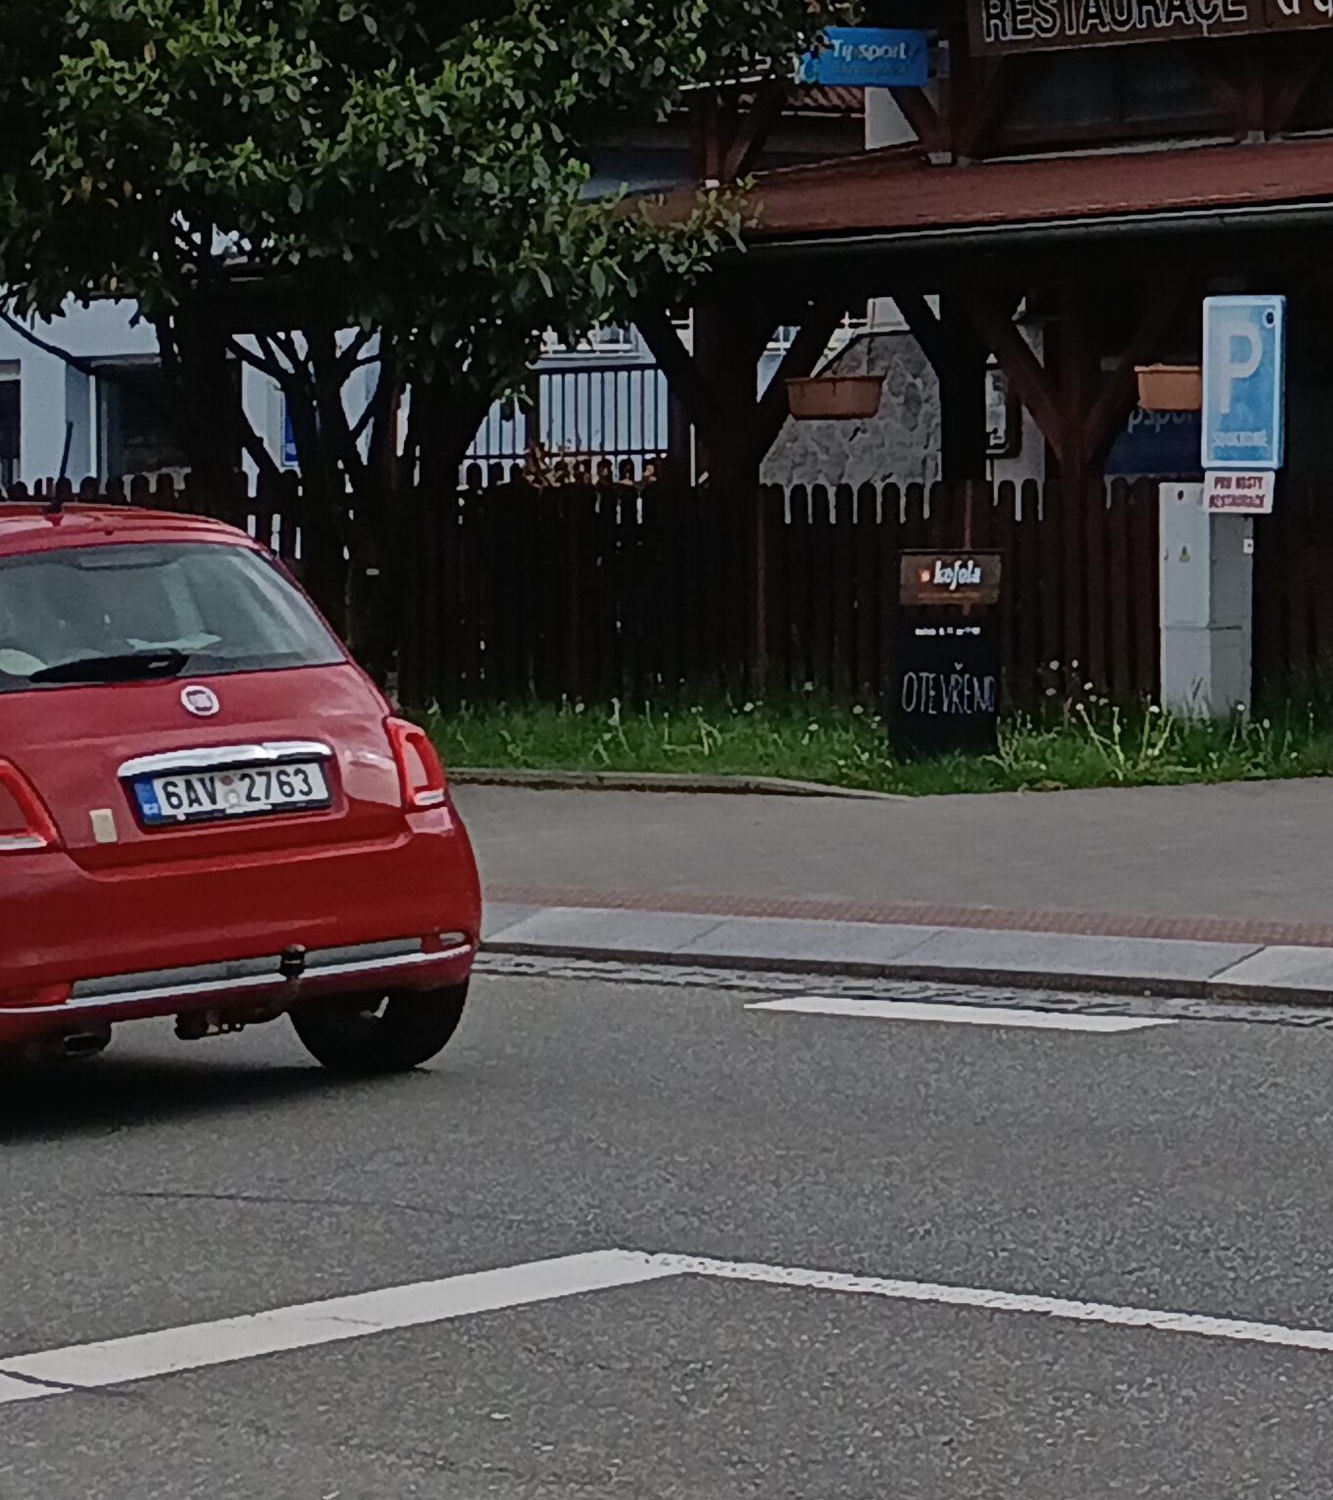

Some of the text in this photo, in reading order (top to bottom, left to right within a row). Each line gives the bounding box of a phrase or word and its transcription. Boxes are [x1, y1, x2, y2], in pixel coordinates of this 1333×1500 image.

[1218, 321, 1264, 415] P
[162, 767, 314, 810] 6AV 2763
